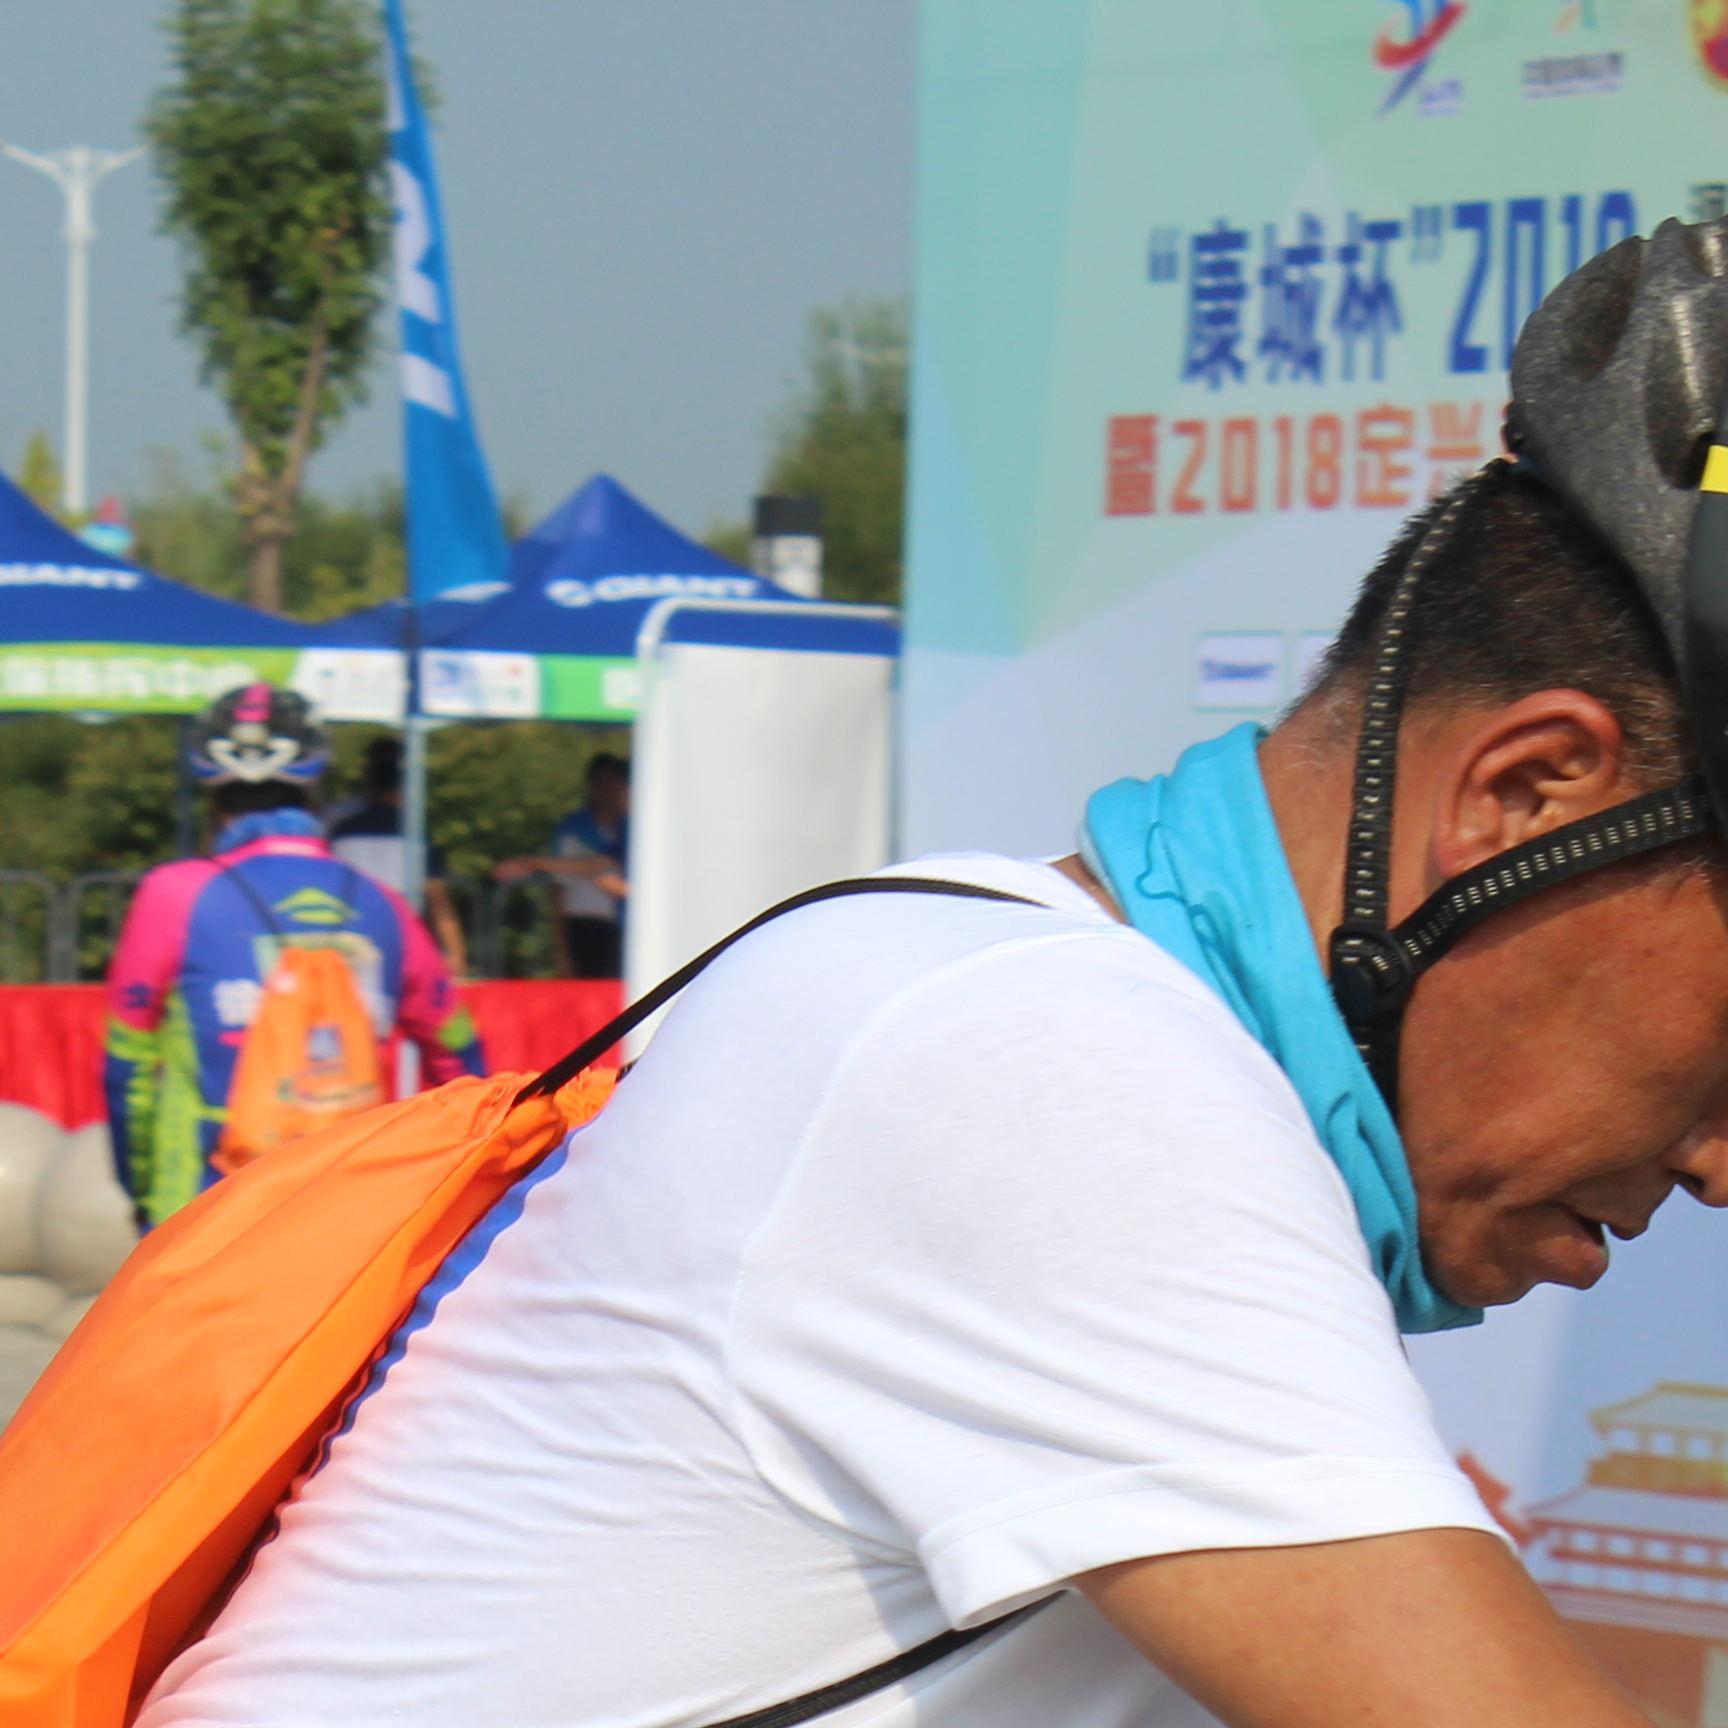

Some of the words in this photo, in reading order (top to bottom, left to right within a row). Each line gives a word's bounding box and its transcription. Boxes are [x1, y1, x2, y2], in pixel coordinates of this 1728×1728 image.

[1103, 402, 1512, 517] 暨2018定兴
[590, 573, 760, 601] GIANT
